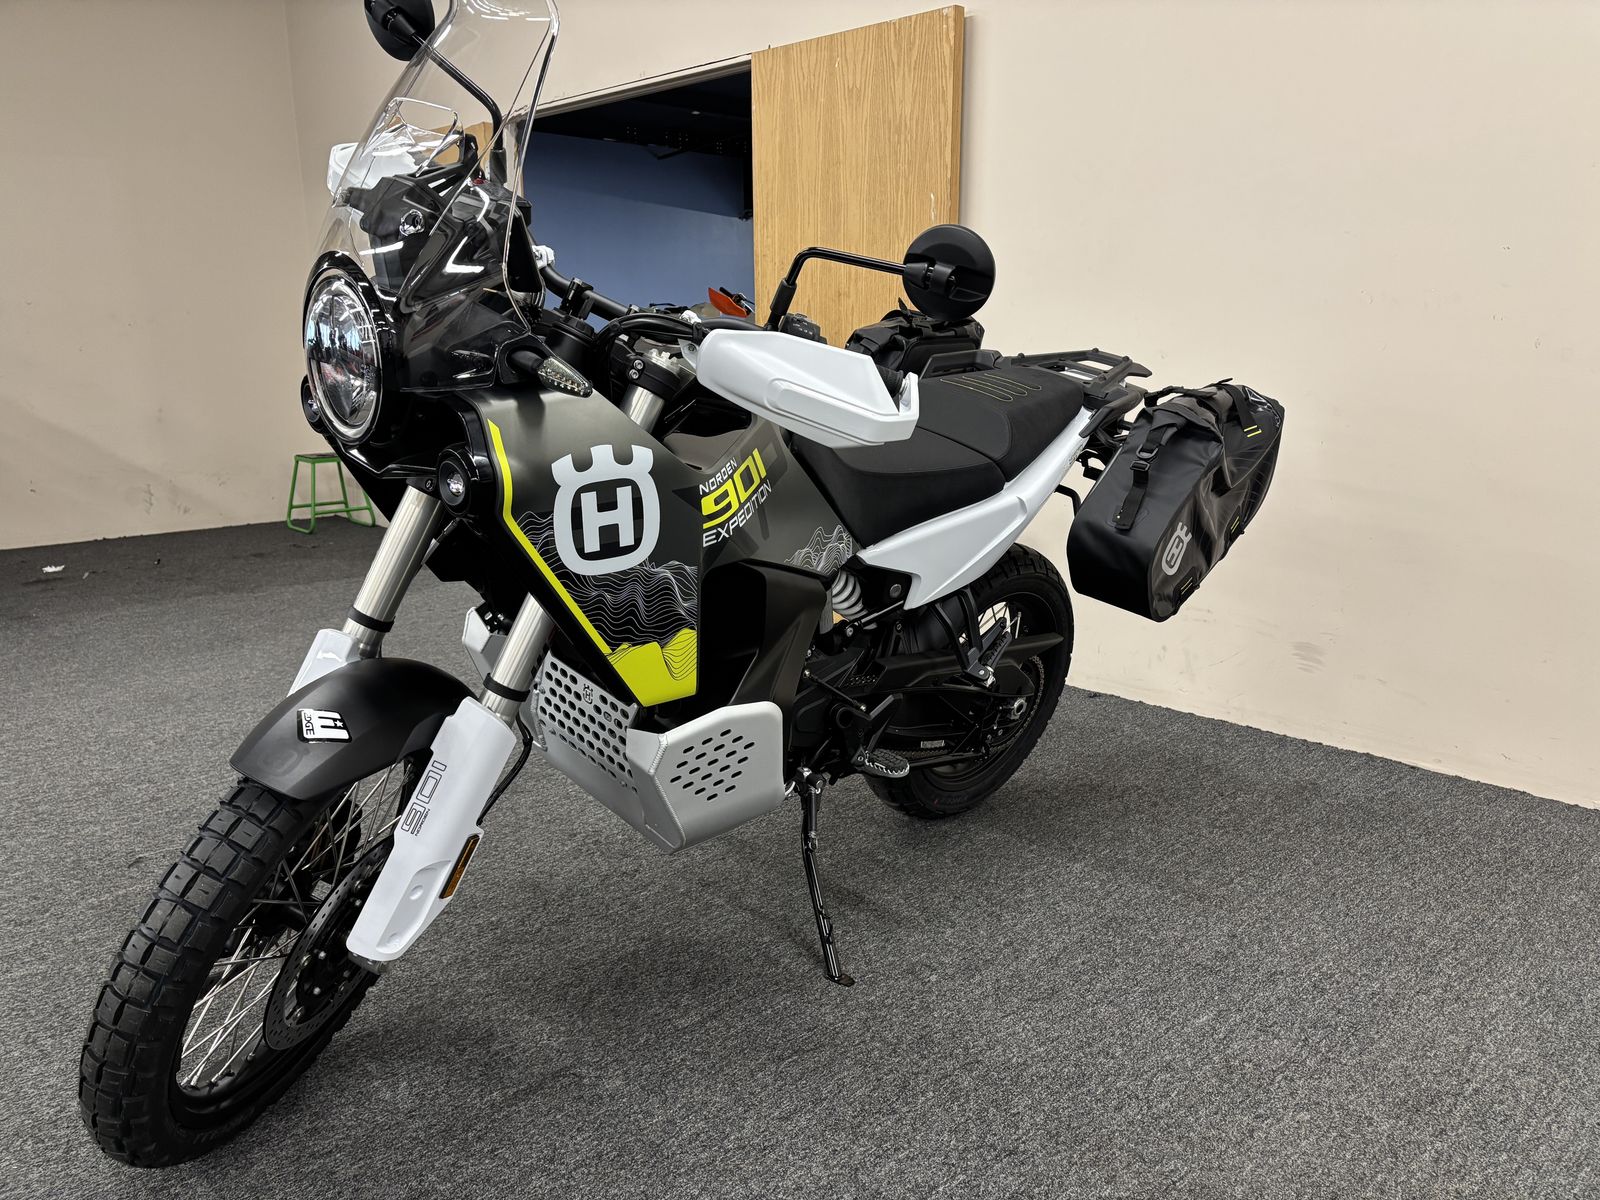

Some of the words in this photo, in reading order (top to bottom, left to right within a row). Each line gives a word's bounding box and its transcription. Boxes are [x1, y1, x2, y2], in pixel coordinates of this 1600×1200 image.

[699, 457, 737, 494] NORDEN
[701, 448, 767, 529] 901
[581, 485, 634, 553] H
[703, 479, 772, 548] EXPEDITION
[401, 760, 447, 834] 901
